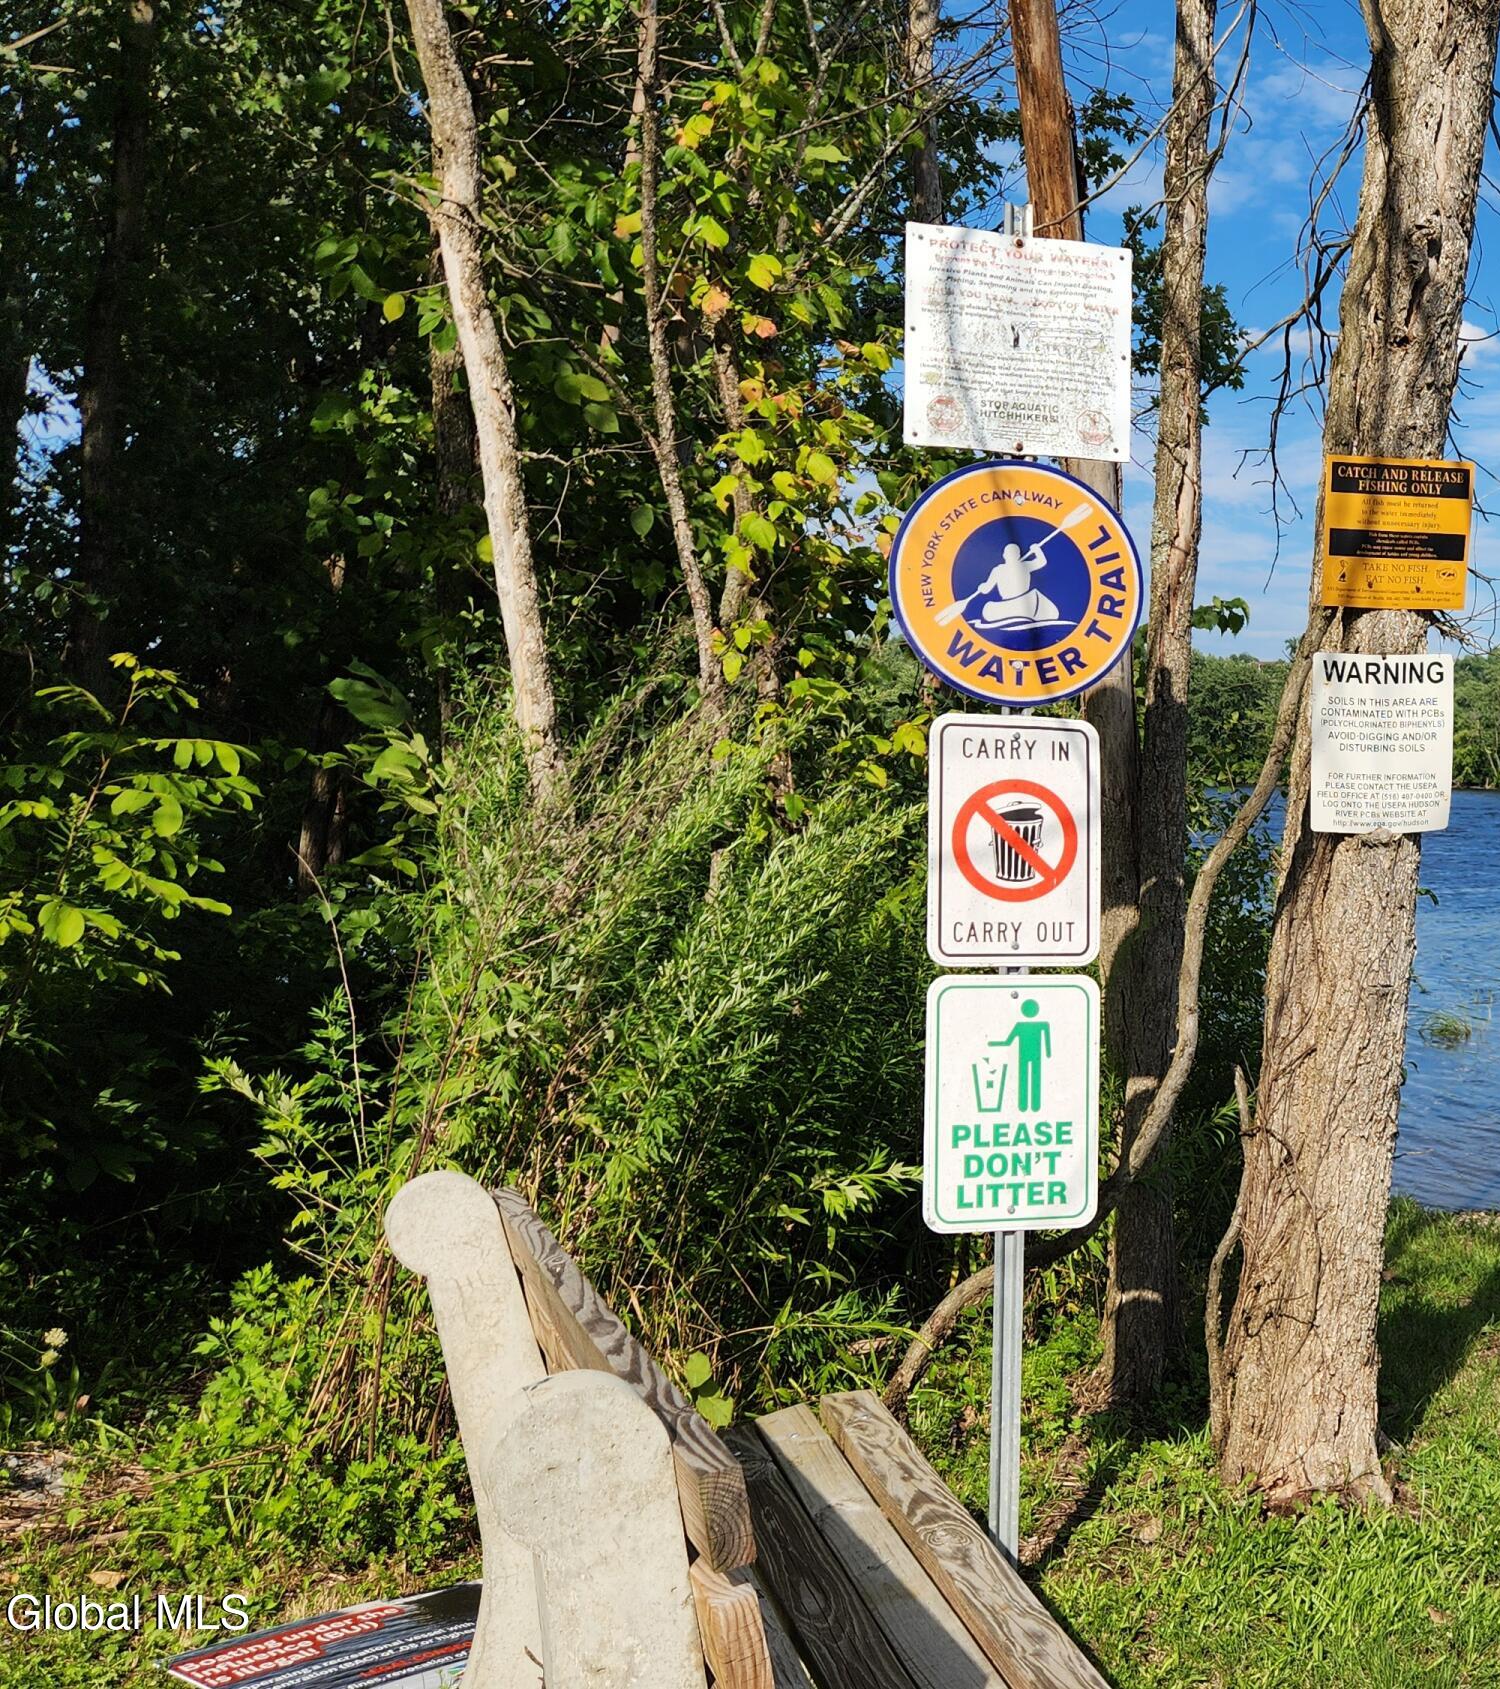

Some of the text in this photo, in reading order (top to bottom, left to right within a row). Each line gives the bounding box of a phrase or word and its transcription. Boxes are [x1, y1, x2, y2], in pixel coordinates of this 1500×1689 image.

[1005, 249, 1043, 263] YOUR
[981, 399, 1060, 414] STOP AQUATIC
[1337, 465, 1465, 484] CATCH AND RELEASE
[1358, 480, 1443, 495] FISHING ONLY
[921, 489, 1063, 608] NEW YORK STATE CANALWAY
[1362, 562, 1389, 572] TAKE
[1391, 563, 1406, 573] NO
[1366, 575, 1384, 584] EAT
[1387, 575, 1402, 584] NO
[946, 524, 1128, 686] WATER TRAIL
[1323, 659, 1445, 685] WARNING
[1328, 696, 1439, 707] SOILS IN THIS AREA ARE
[1320, 707, 1445, 719] CONTAMINATED WITH PCBs
[1320, 718, 1446, 729] (POLYCHLORINATED BIPHENYLS)
[1328, 731, 1438, 741] AVOID DIGGING AND/OR
[962, 737, 1070, 761] CARRY IN
[1339, 742, 1426, 753] DISTURBING SOILS
[1328, 772, 1437, 781] FOR FURTHER INFORMATION
[1325, 781, 1356, 790] PLEASE
[1357, 782, 1394, 791] CONTACT
[1413, 782, 1438, 790] USEPA
[1317, 790, 1339, 798] FIELD
[1341, 791, 1369, 799] OFFICE
[1370, 792, 1380, 800] AT
[1322, 800, 1441, 809] LOG ONTO THE USEPA HUDSON
[1335, 809, 1427, 818] RIVER PCBs WEBSITE AT
[953, 921, 1075, 942] CARRY OUT
[952, 1121, 1073, 1149] PLEASE
[964, 1151, 1062, 1179] DON'T
[956, 1181, 1067, 1210] LITTER
[179, 1607, 400, 1672] Boating under the
[322, 1639, 406, 1667] recreational
[405, 1628, 447, 1643] vessel
[447, 1622, 476, 1632] with
[190, 1640, 314, 1679] influence
[315, 1621, 379, 1642] (BUI)
[339, 1655, 379, 1670] (BAC)
[381, 1648, 394, 1657] of
[420, 1639, 434, 1647] or
[204, 1674, 232, 1687] is
[231, 1647, 320, 1678] illegal!
[386, 1655, 454, 1679] revocation
[454, 1649, 468, 1659] of
